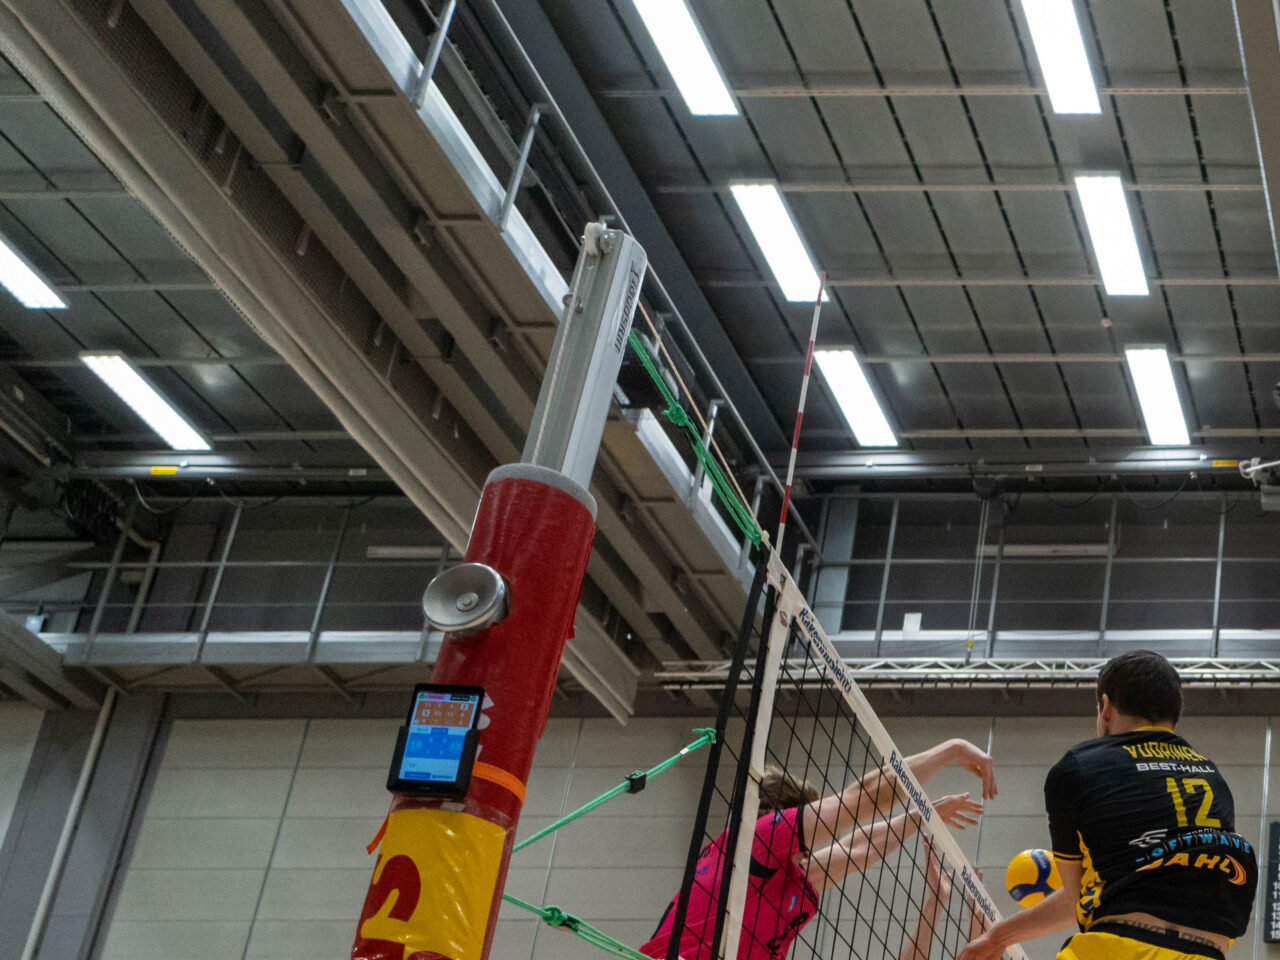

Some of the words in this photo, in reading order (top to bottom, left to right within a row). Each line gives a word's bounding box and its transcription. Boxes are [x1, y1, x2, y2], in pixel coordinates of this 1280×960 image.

[1122, 741, 1208, 761] VUORINEN
[1136, 762, 1215, 773] BEST-HALL
[890, 750, 933, 823] Rakennuslehti
[1166, 777, 1221, 828] 12
[1136, 833, 1250, 862] OFTWAVE
